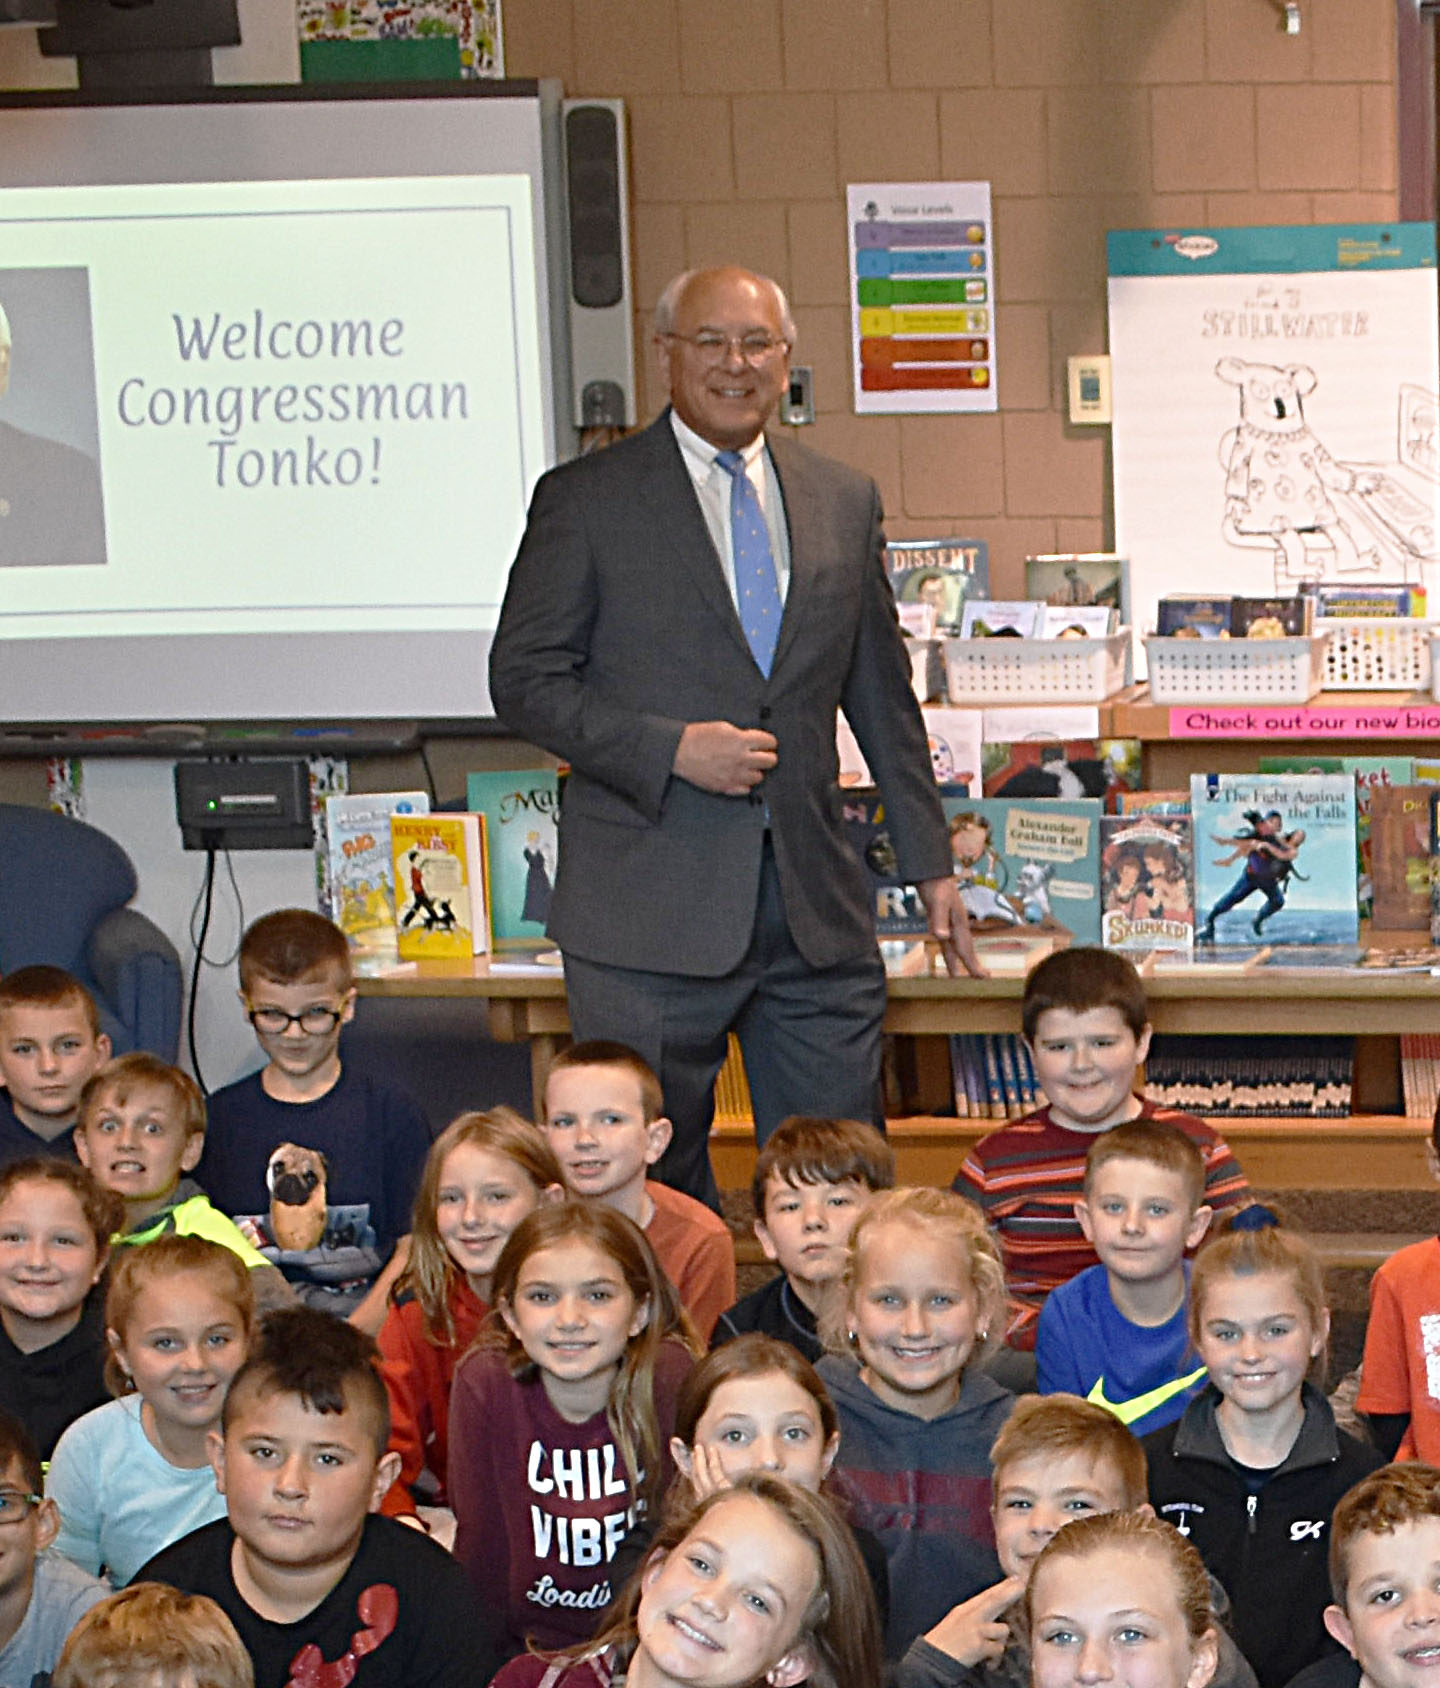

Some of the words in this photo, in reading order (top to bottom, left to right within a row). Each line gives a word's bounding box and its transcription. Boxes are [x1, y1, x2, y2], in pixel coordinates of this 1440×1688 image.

[172, 308, 405, 363] Welcome
[1202, 308, 1371, 340] STILLWATER
[116, 375, 470, 437] Congressman
[207, 435, 383, 489] Tonko!
[892, 547, 979, 573] DISSENT
[1186, 711, 1258, 731] Check
[1264, 713, 1303, 730] out
[1309, 714, 1348, 730] our
[1354, 713, 1397, 730] new
[1225, 787, 1248, 803] The
[1253, 790, 1289, 805] Fight
[1293, 789, 1346, 806] Against
[1289, 804, 1310, 819] the
[1315, 806, 1347, 820] Falls
[1018, 816, 1078, 833] Alexander
[1009, 830, 1057, 844] Graham
